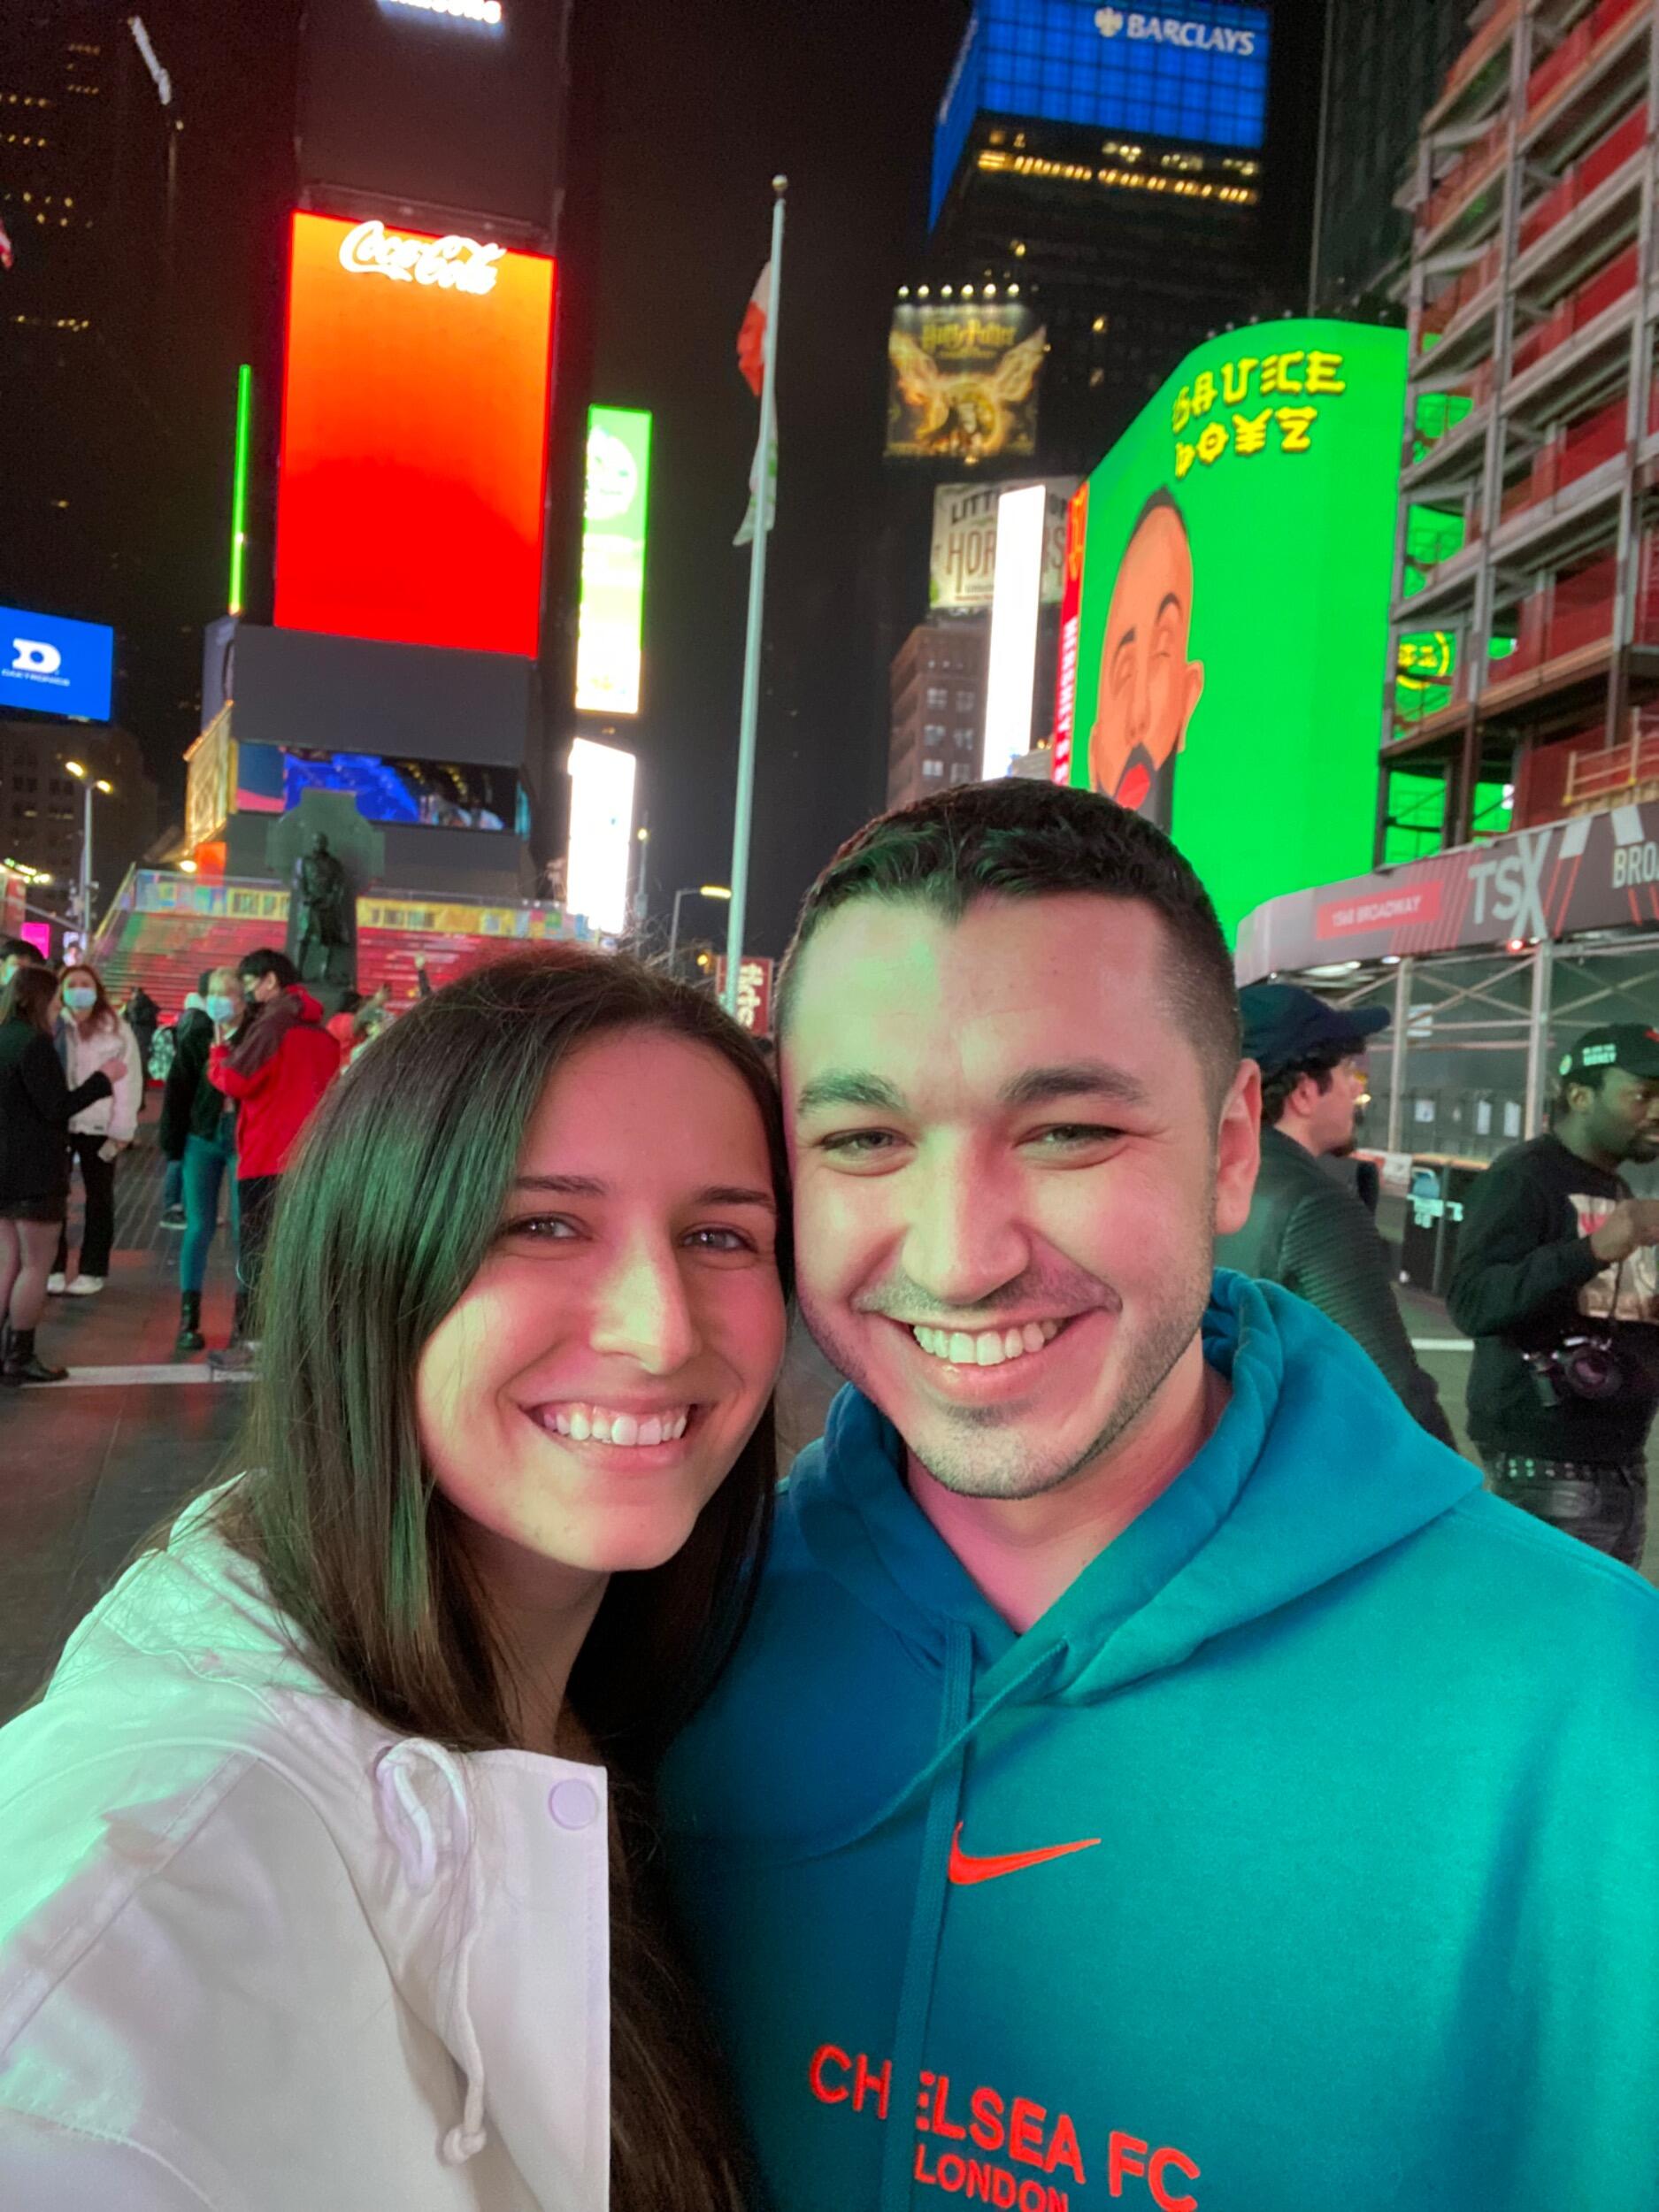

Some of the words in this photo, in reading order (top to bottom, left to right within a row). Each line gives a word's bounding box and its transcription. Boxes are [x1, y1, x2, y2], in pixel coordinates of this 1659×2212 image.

[1126, 13, 1255, 56] BARCLAYS
[1468, 828, 1548, 940] TSX
[1611, 841, 1659, 889] BRO
[914, 2143, 1069, 2212] LONDON
[1109, 2131, 1202, 2212] FC
